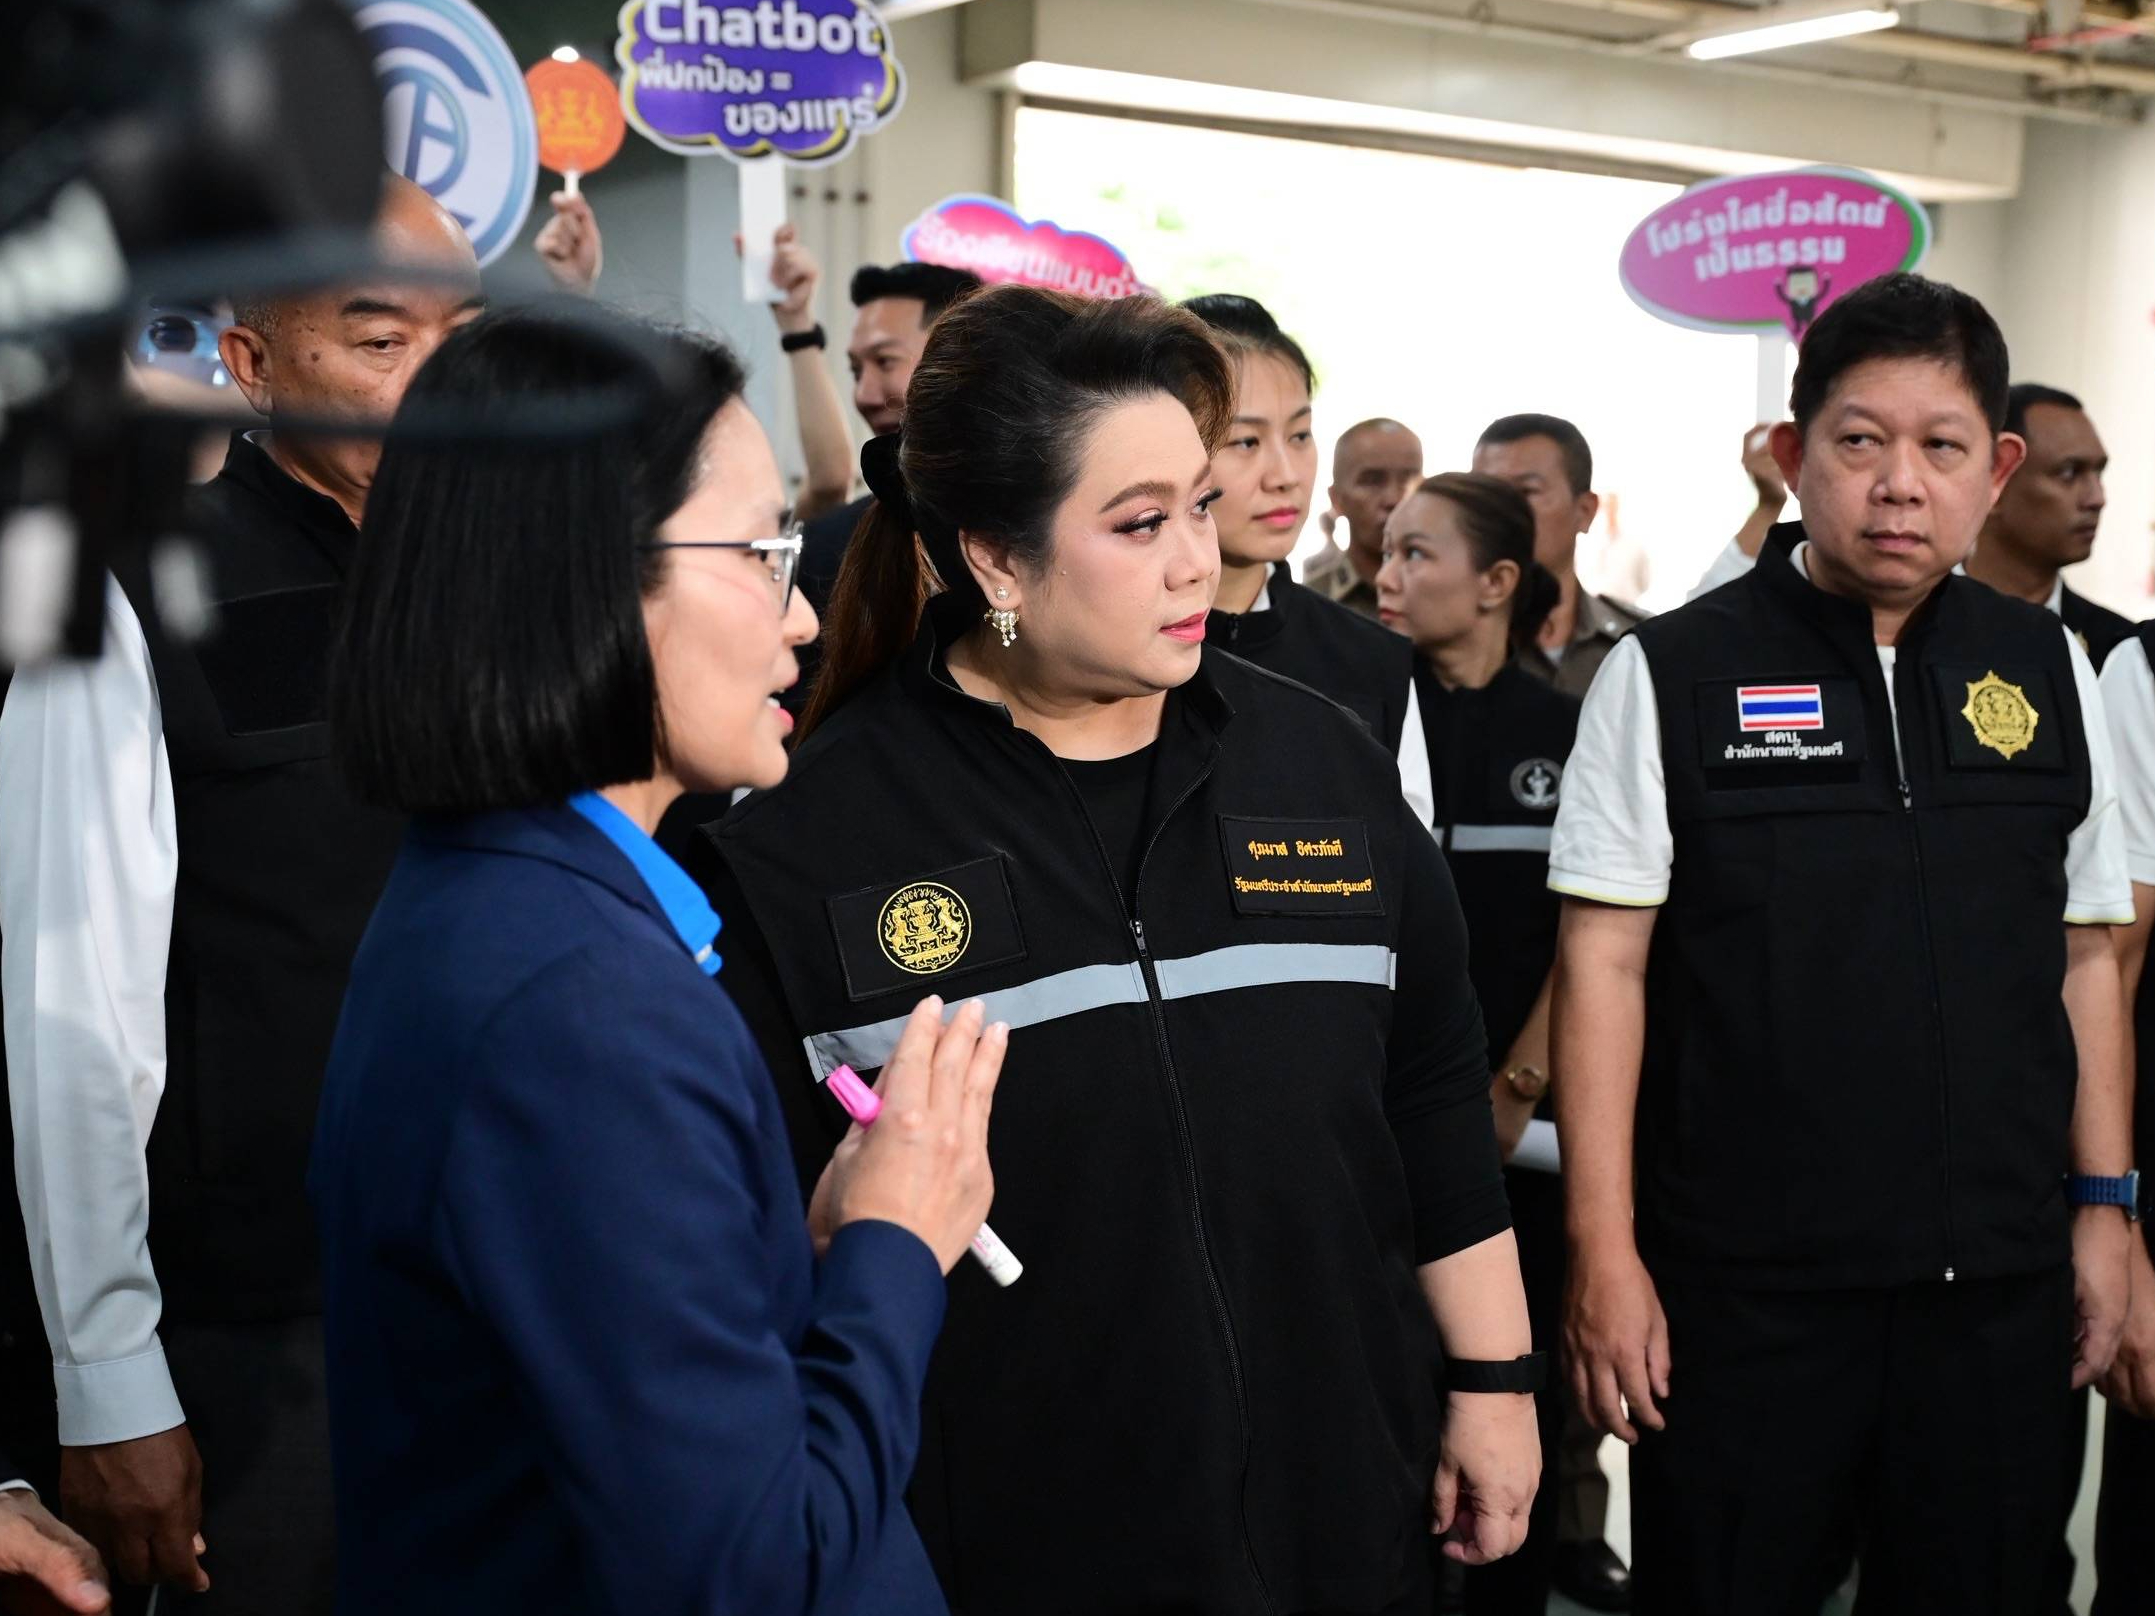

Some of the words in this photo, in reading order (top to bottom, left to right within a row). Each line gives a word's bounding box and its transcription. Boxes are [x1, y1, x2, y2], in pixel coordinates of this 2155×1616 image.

[643, 0, 880, 55] Chatbot
[640, 47, 764, 93] พี่ปกป้อง
[724, 83, 877, 135] ของแทร่
[1647, 188, 1893, 258] โปร่งใสซื่อสัตย์
[1695, 233, 1846, 281] เป็นธรรม
[1725, 741, 1843, 760] สำนักนายกรัฐมนตรี
[1248, 840, 1288, 861] ศุภมาส
[1234, 876, 1372, 896] รัฐมนตรีประจำสำนักนายกรัฐมนตรี
